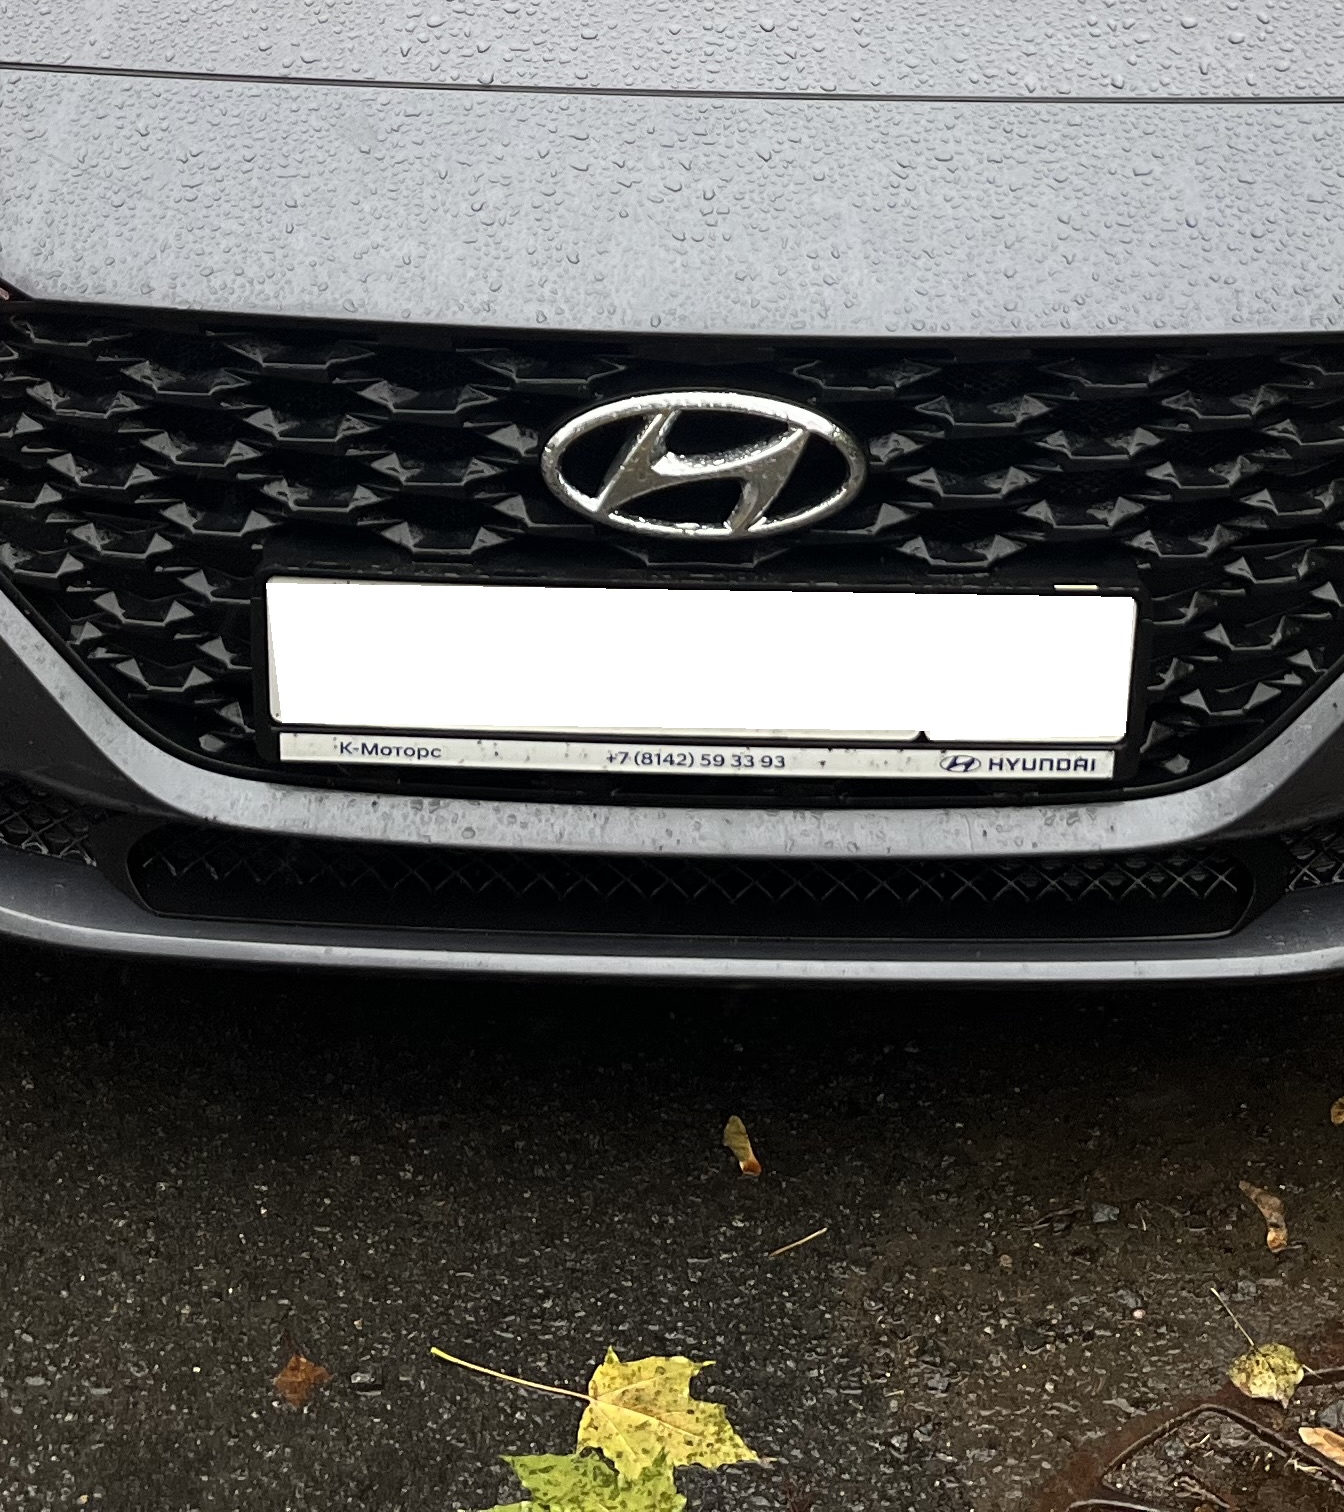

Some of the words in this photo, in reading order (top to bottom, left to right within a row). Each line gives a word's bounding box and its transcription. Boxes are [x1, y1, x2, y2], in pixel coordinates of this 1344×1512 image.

[339, 741, 442, 760] К-Моторс
[606, 751, 629, 765] +7
[634, 750, 695, 768] (8142)
[700, 753, 725, 767] 59
[730, 754, 755, 768] 33
[760, 754, 785, 769] 93
[988, 757, 1096, 772] HYUNDAI
